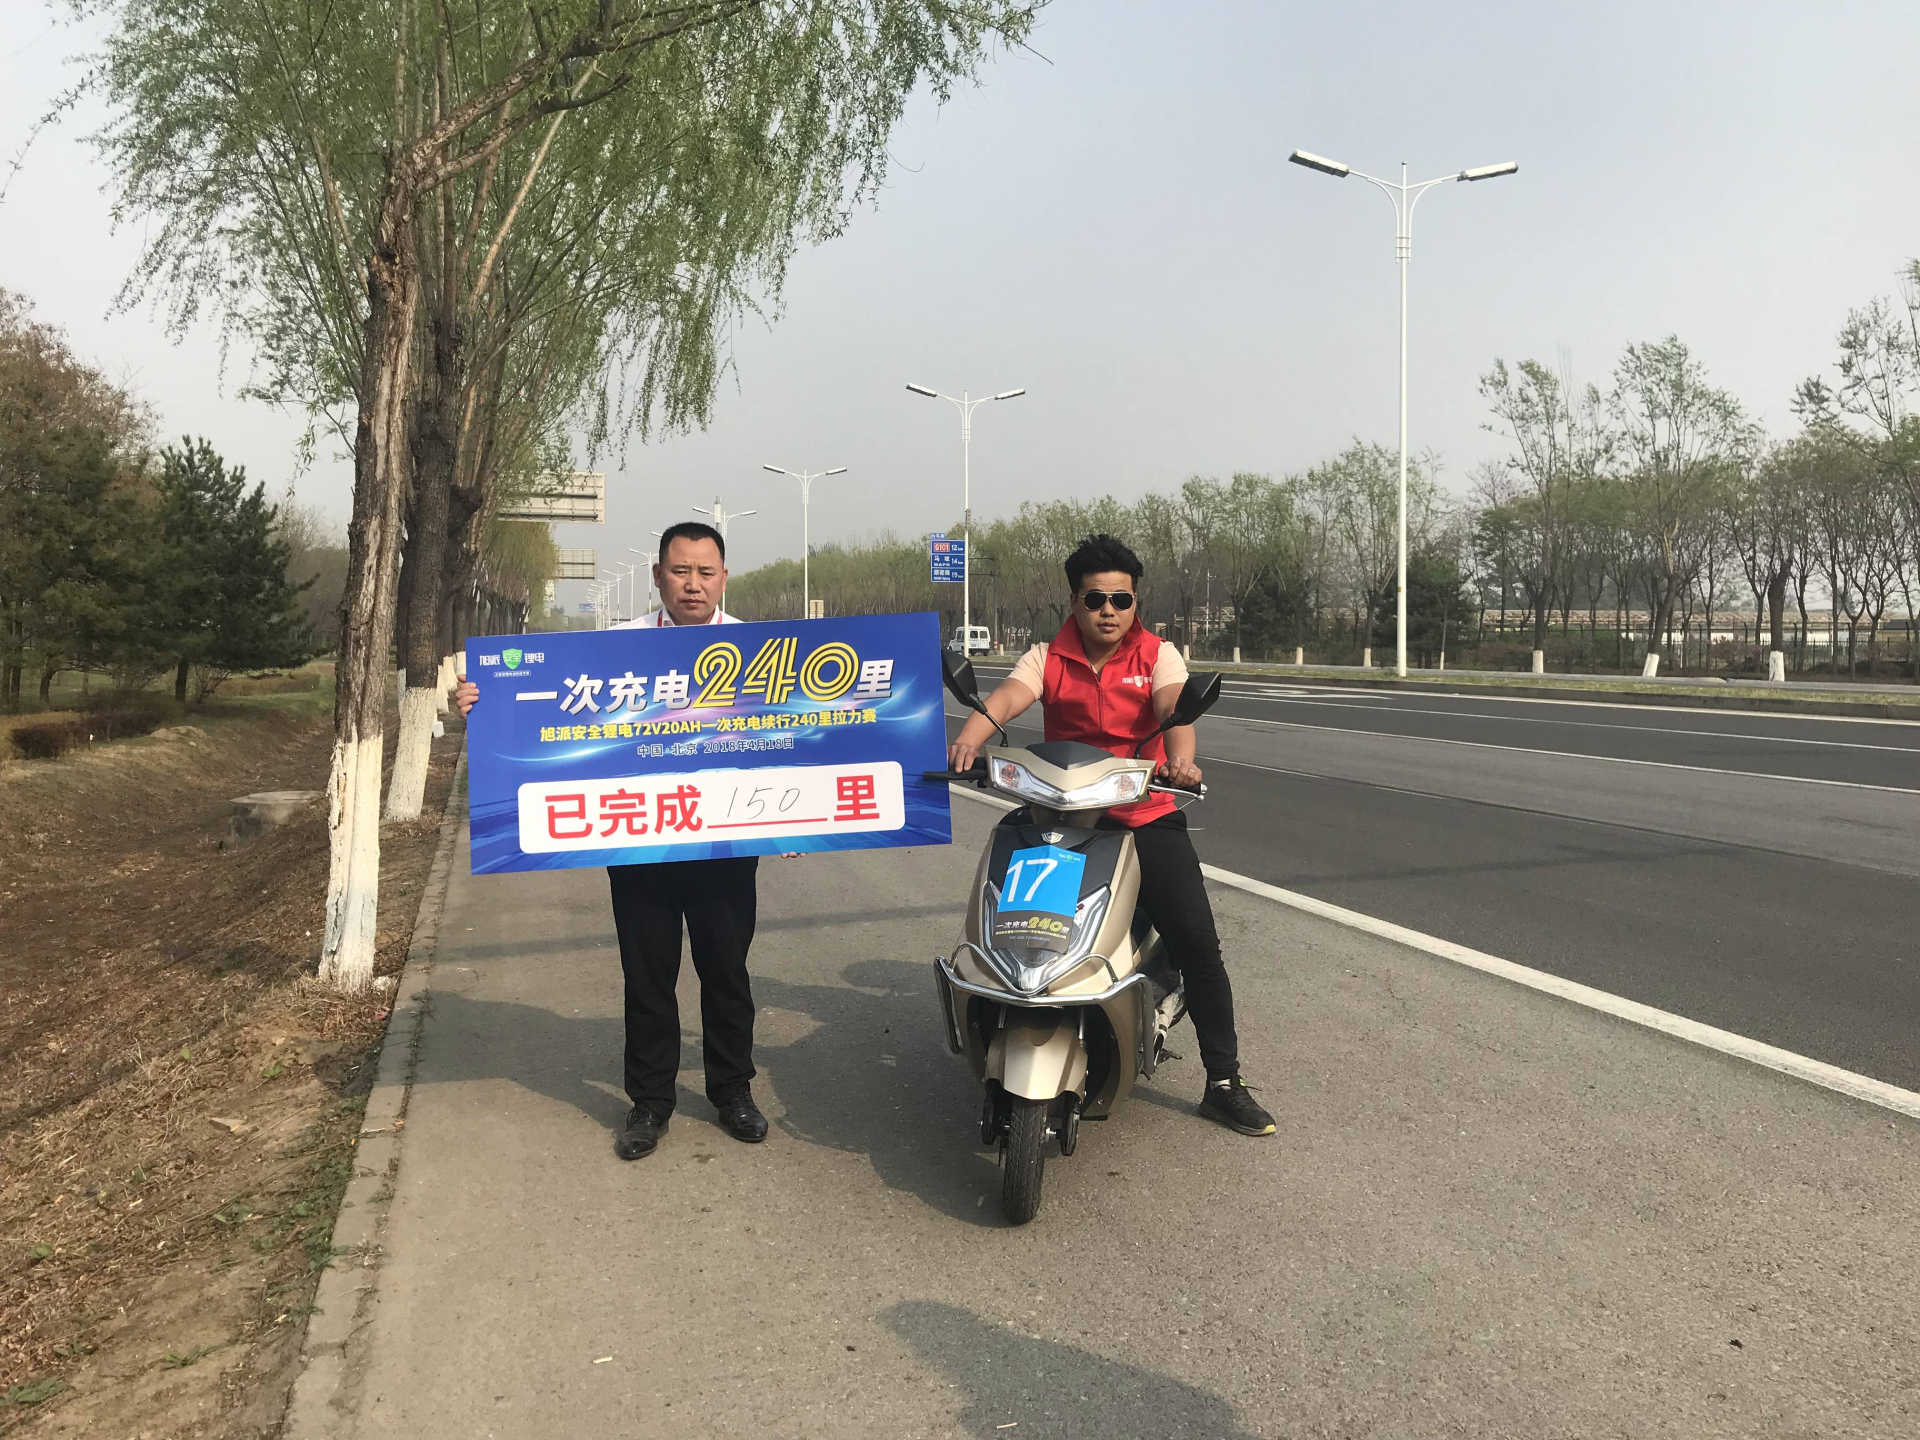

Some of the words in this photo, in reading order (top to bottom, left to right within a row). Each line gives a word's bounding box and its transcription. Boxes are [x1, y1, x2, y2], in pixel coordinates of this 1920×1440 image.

[515, 637, 894, 715] 一次充电240里
[703, 737, 794, 754] 2018年4月18日
[545, 784, 703, 839] 已完成
[727, 786, 801, 820] 150
[833, 774, 881, 822] 里
[1007, 858, 1058, 903] 17
